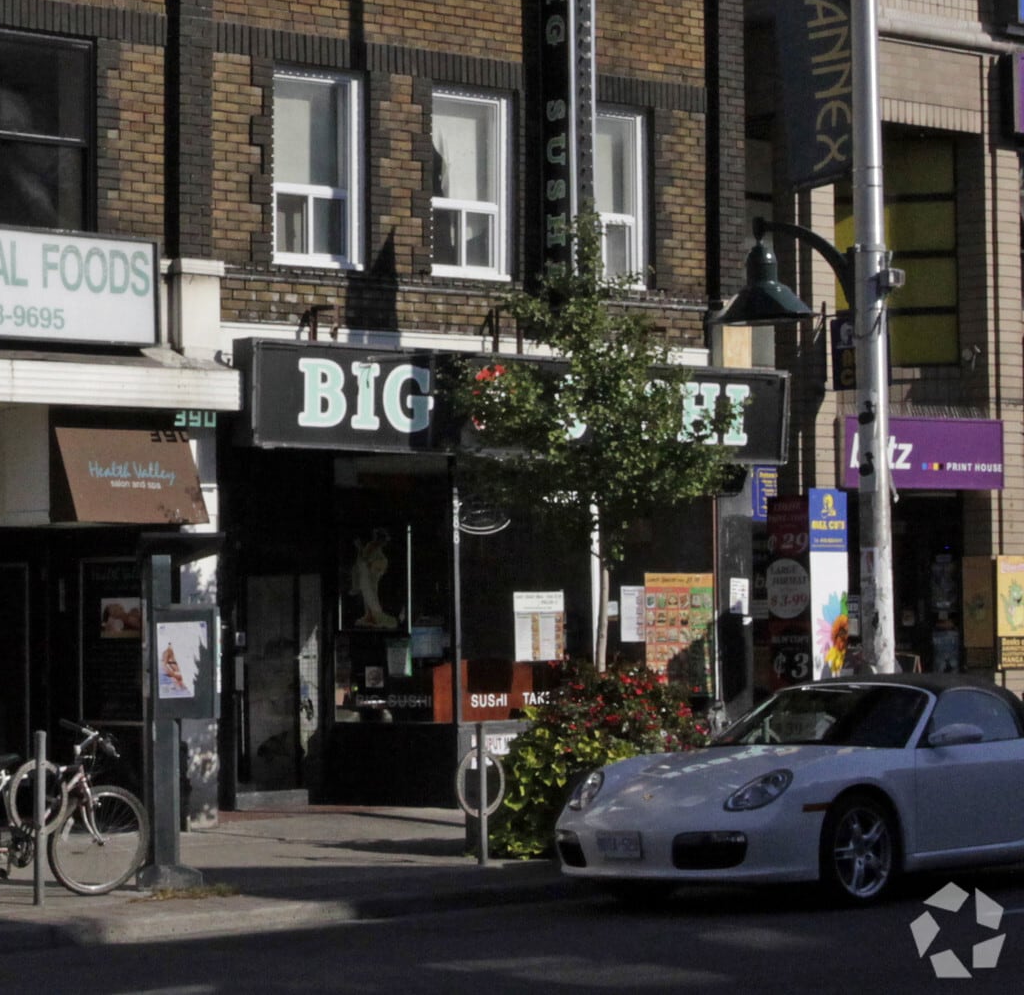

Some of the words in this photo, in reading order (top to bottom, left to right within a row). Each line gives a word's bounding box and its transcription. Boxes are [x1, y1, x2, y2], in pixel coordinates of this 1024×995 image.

[41, 243, 151, 298] FOODS
[298, 357, 434, 433] BIG
[174, 410, 217, 427] 390
[88, 460, 131, 478] Health
[132, 461, 176, 486] Valley
[946, 462, 974, 471] PRINT
[975, 463, 1002, 472] HOUSE
[387, 694, 432, 708] SUSHI
[471, 693, 508, 708] SUSHI
